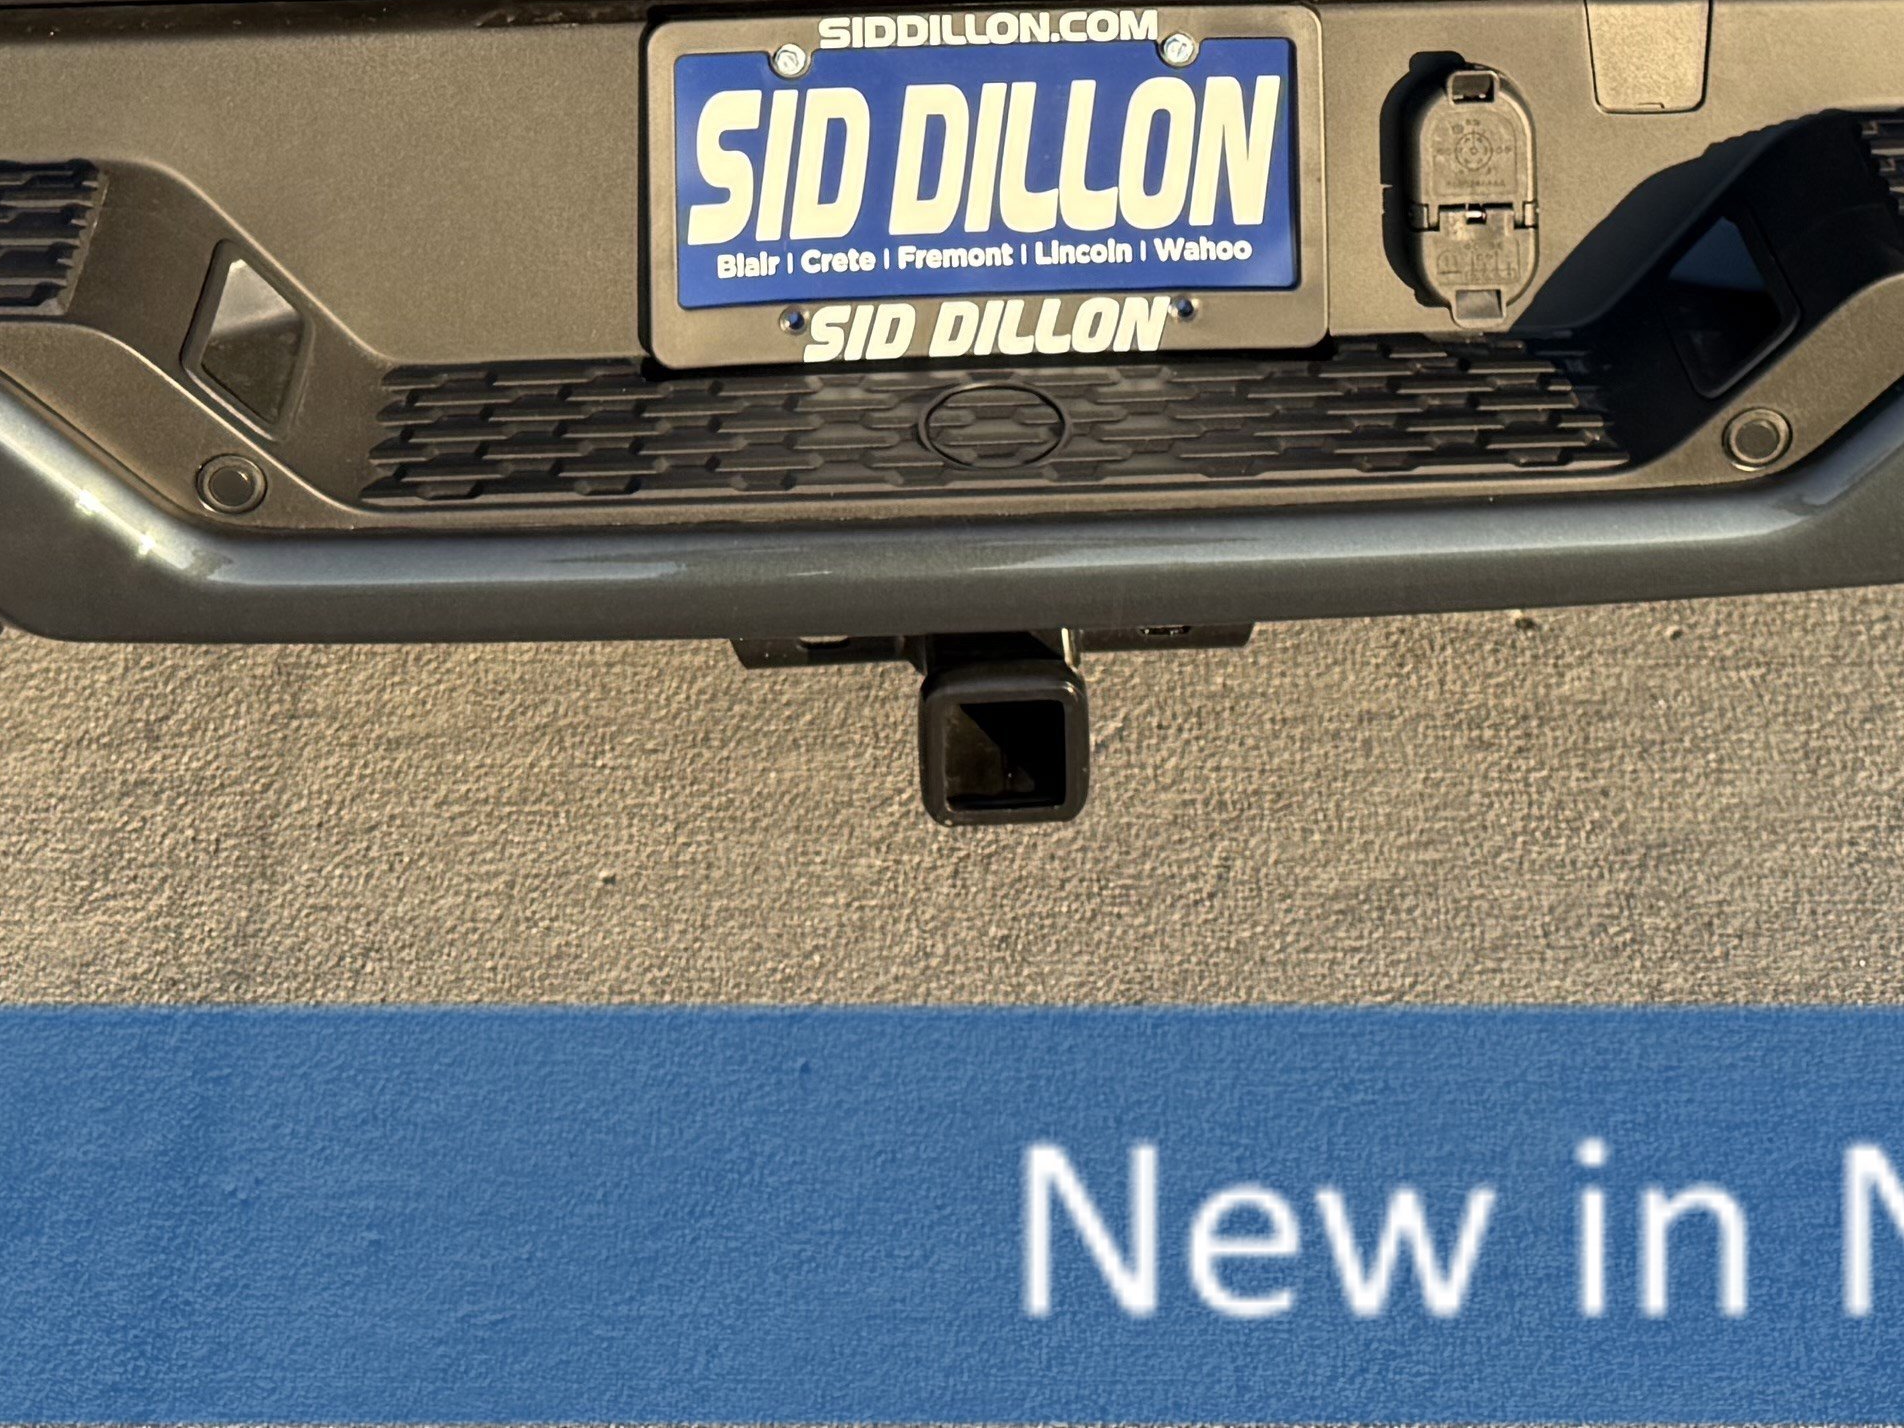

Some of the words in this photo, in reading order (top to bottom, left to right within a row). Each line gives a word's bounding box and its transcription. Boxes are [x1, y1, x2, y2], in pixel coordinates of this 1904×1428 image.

[818, 10, 1158, 49] SIDDILLON.COM
[687, 88, 871, 245] SID
[889, 75, 1281, 235] DILLON
[717, 251, 780, 278] Blair
[800, 248, 876, 274] Crete
[898, 242, 1014, 270] Fremont
[1035, 237, 1133, 266] Lincoln
[1153, 236, 1253, 262] Wahoo
[803, 304, 917, 363] SID
[928, 296, 1171, 357] DILLON
